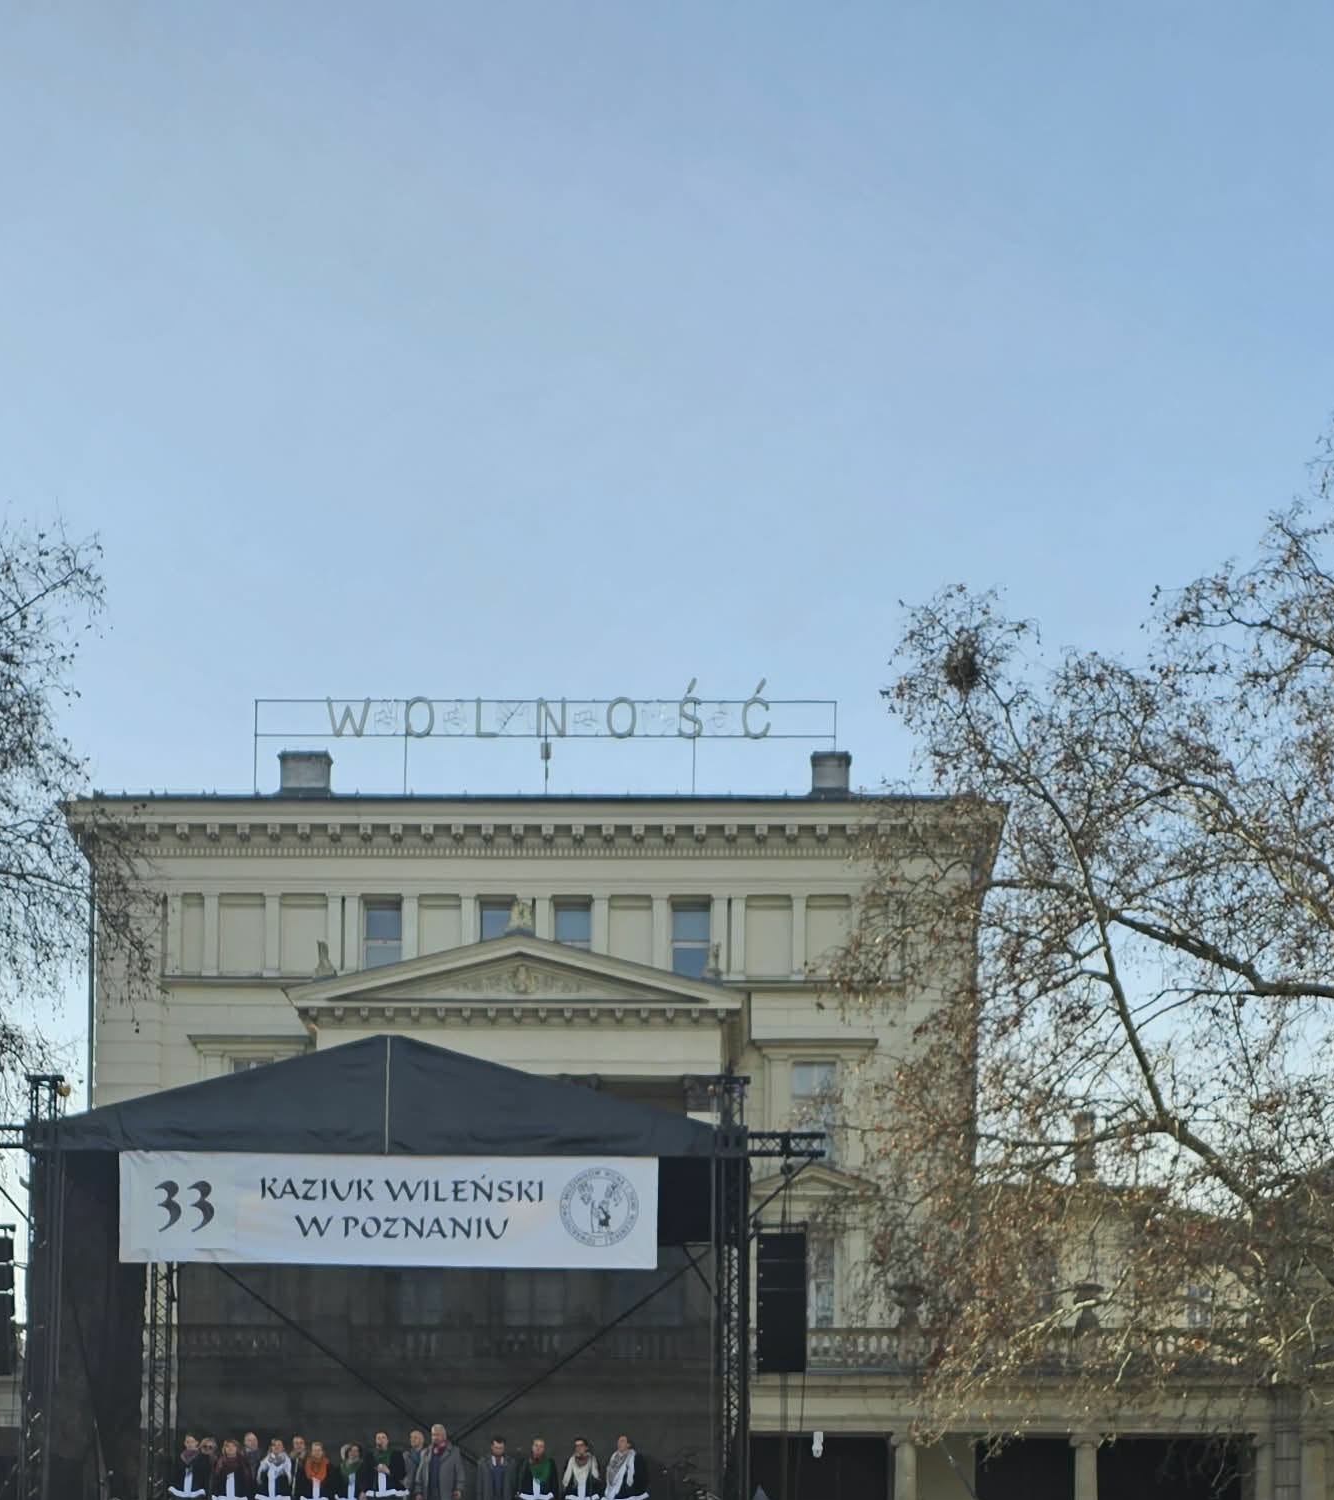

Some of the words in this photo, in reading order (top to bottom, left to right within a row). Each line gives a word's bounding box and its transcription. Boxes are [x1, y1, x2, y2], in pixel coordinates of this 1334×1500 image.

[326, 678, 771, 738] WOLNOŚĆ
[154, 1180, 215, 1233] 33
[260, 1177, 374, 1202] KAZIUK
[384, 1174, 544, 1203] WILEŃSKI
[295, 1214, 333, 1238] W
[342, 1215, 509, 1240] POZNANIU
